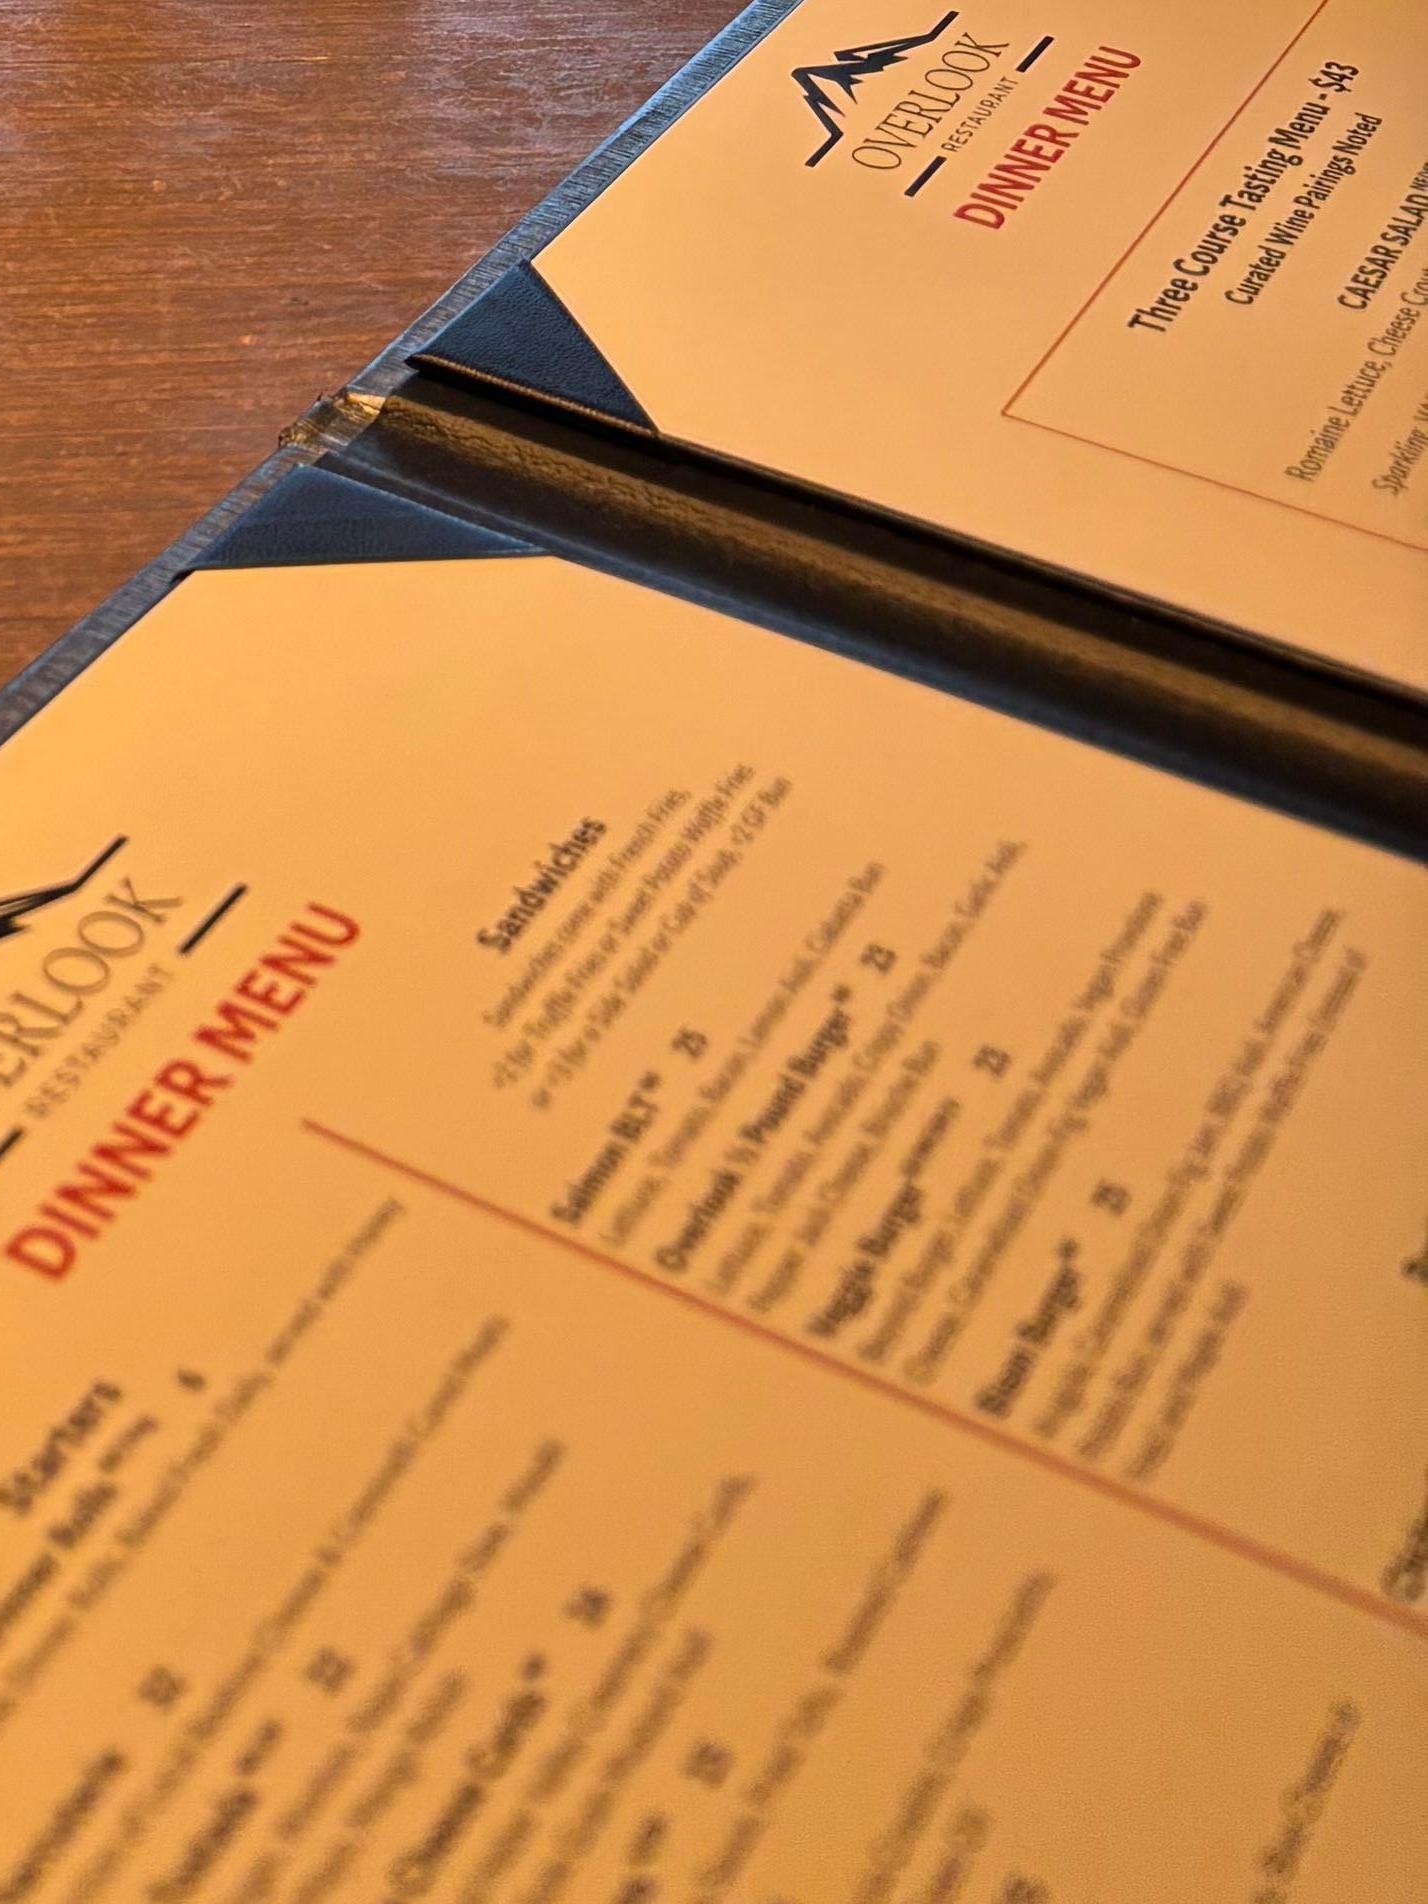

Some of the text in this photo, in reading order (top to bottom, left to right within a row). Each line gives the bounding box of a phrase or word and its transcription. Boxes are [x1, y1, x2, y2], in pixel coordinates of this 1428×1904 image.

[852, 32, 1010, 169] OVERLOOK
[941, 77, 1019, 152] RESTAURANT
[953, 46, 1141, 229] DINNER MENU
[1128, 277, 1198, 333] Three
[1172, 213, 1246, 278] Course
[1220, 148, 1303, 212] Tasting
[1268, 101, 1330, 149] Menu
[1308, 61, 1359, 93] $43
[1225, 113, 1383, 306] Curated Wine Pairings Noted
[1337, 244, 1403, 310] CAESAR
[1284, 415, 1350, 483] Romaine
[1367, 307, 1420, 357] Cheese
[476, 816, 608, 954] Sandwiches
[1, 900, 363, 1281] DINNER MENU
[24, 963, 179, 1123] RESTAURANT
